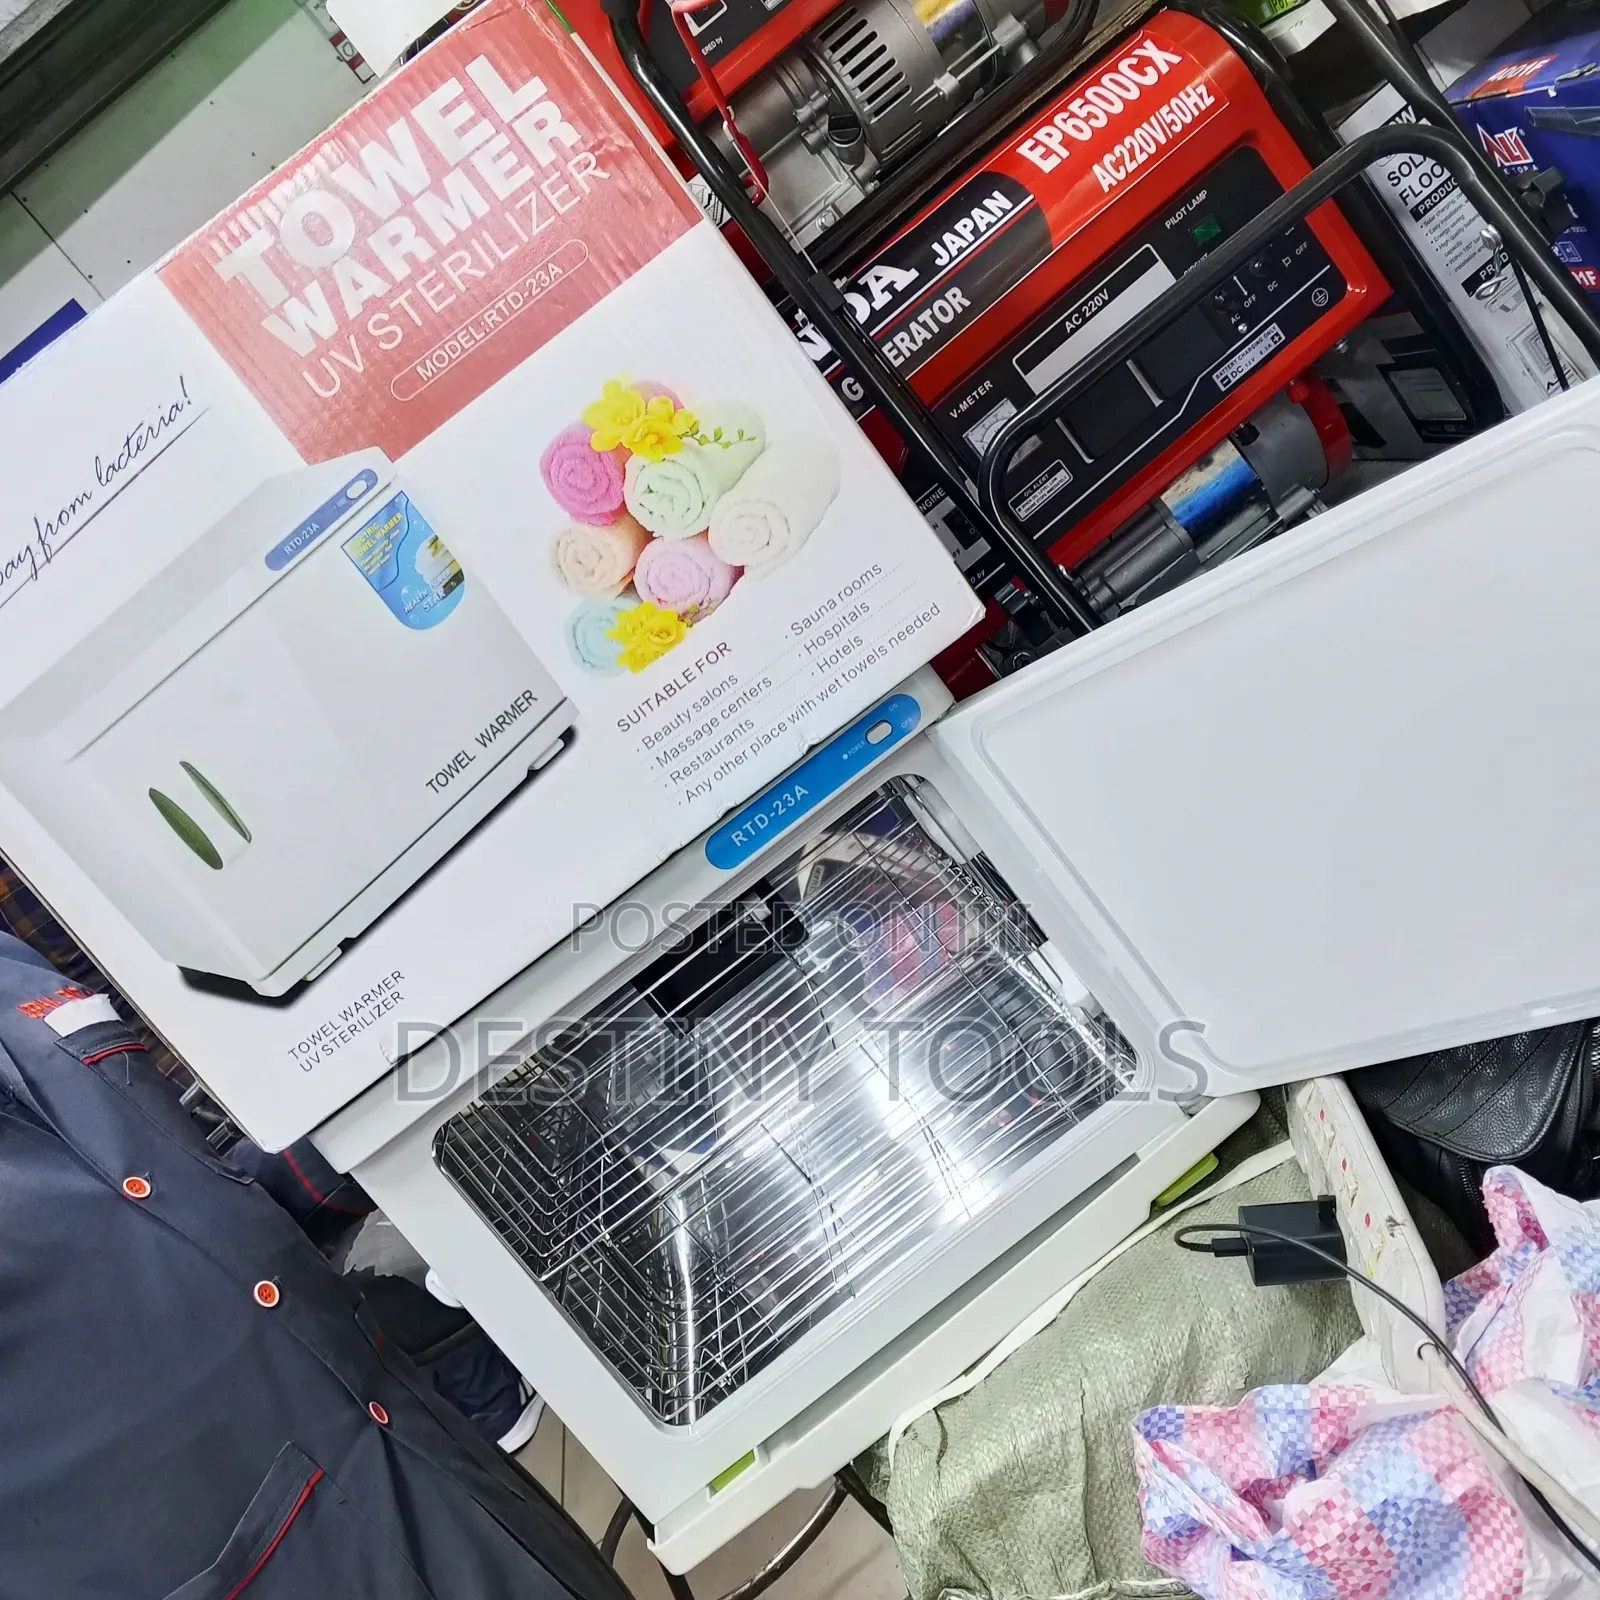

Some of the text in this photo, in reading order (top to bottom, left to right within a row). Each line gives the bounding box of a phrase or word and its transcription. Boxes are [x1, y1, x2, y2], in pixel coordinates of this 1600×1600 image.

[1016, 37, 1183, 173] EP6500CX
[1091, 83, 1217, 193] AC220V/50Hz
[215, 53, 547, 308] TOWEL
[1387, 155, 1427, 187] SOL
[1398, 163, 1446, 206] FLOO
[1418, 176, 1458, 215] PRODUC
[261, 98, 585, 359] WARMER
[929, 189, 1014, 267] JAPAN
[1165, 189, 1208, 230] PILOT LAMP
[300, 147, 611, 399] UV STERILIZER
[1243, 293, 1258, 308] OFF
[1267, 280, 1279, 293] DC
[416, 261, 564, 382] MODEL:RTD-23A
[1065, 288, 1109, 334] AC 220V
[1230, 313, 1241, 325] AC
[1215, 325, 1277, 380] BATTERY CHARGING ONLY
[1230, 365, 1244, 379] DC
[949, 379, 994, 420] V-METER
[919, 486, 947, 513] NGINE
[1023, 473, 1050, 498] OIL ALERT
[32, 511, 93, 564] from
[283, 521, 321, 556] RTD-23A
[790, 562, 883, 638] Sauna rooms
[803, 600, 871, 655] Hospitals
[816, 633, 864, 675] Hotels
[616, 641, 732, 733] SUITABLE FOR
[641, 672, 739, 751] Beauty salons
[684, 601, 942, 804] Any other place with wet towels needed
[425, 689, 539, 796] TOWEL WARMER
[655, 676, 773, 770] Massage centers
[669, 718, 755, 787] Restaurants
[730, 784, 810, 848] RTD-23A
[287, 970, 406, 1061] TOWEL WARMER
[299, 990, 406, 1073] UV STERILIZER
